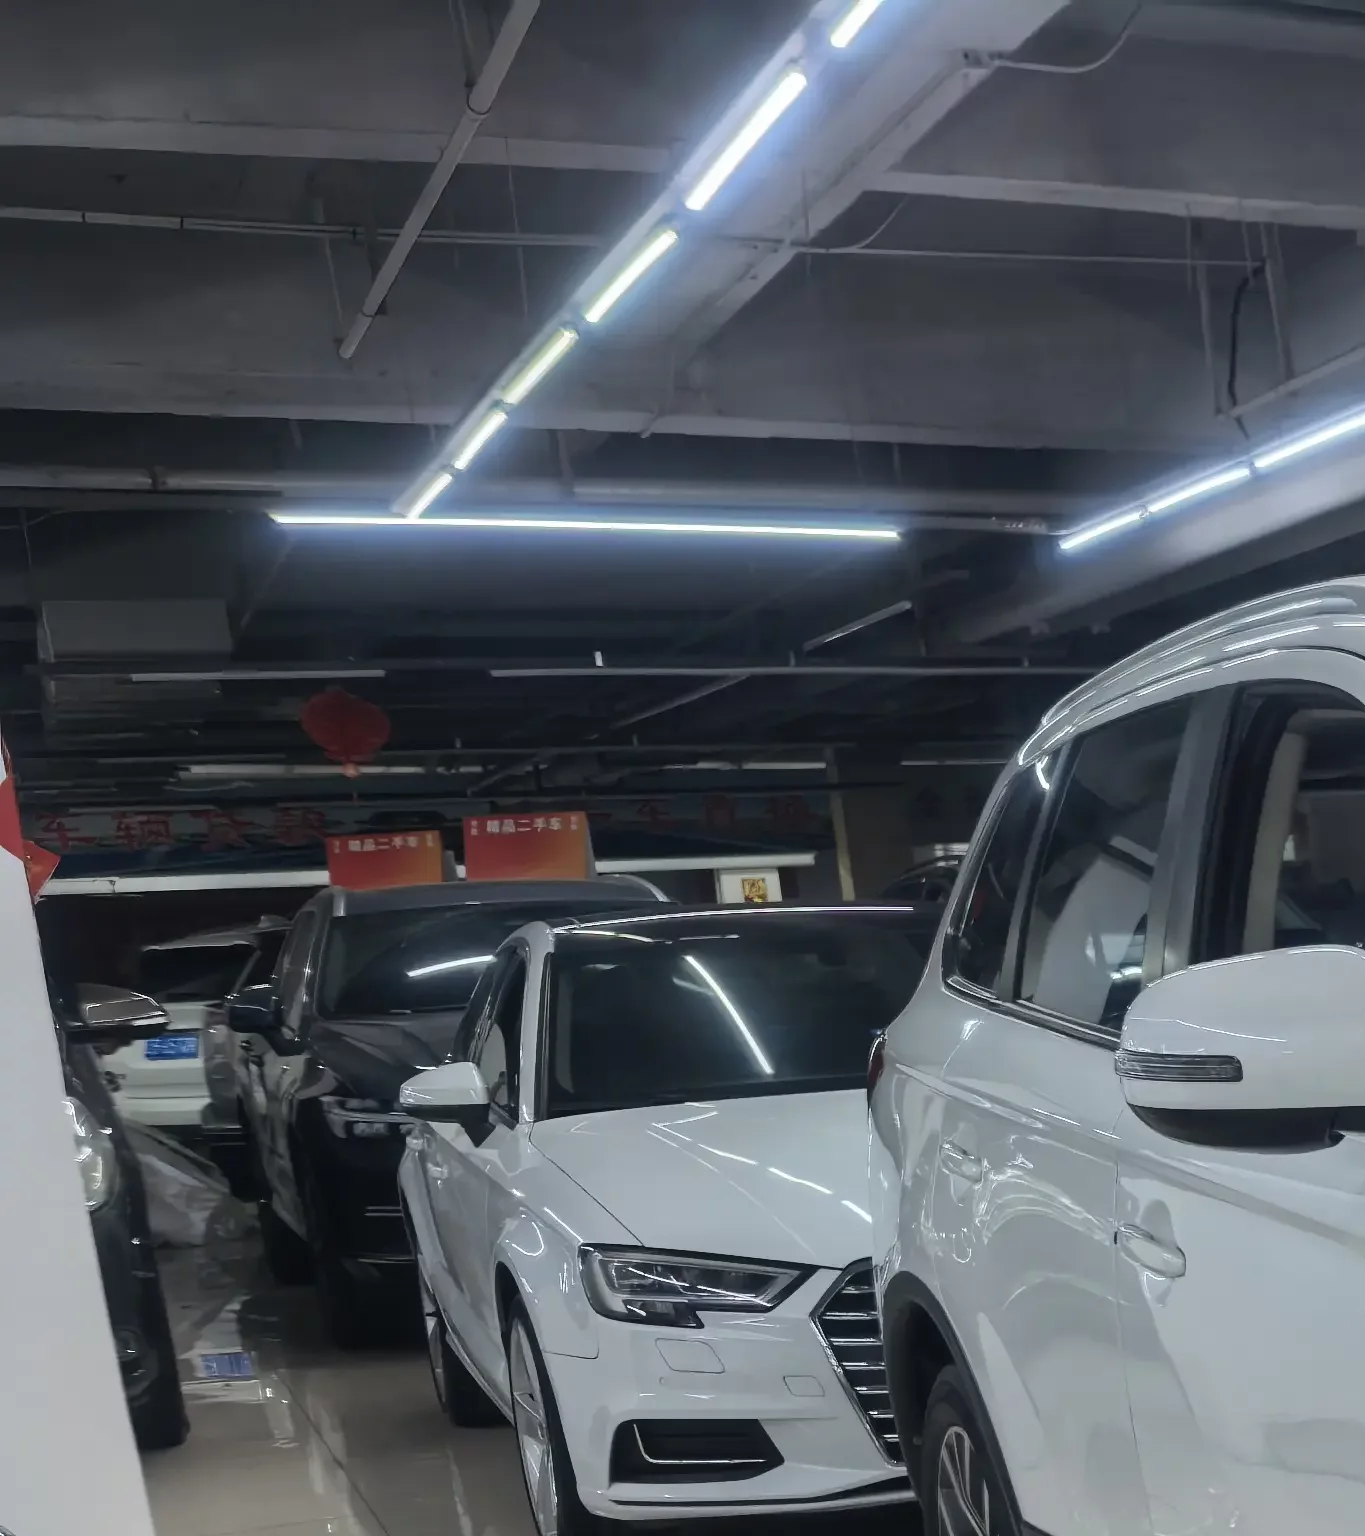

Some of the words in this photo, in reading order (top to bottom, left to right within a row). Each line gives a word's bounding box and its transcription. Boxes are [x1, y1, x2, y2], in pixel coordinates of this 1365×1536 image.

[486, 818, 564, 833] 精品二手车
